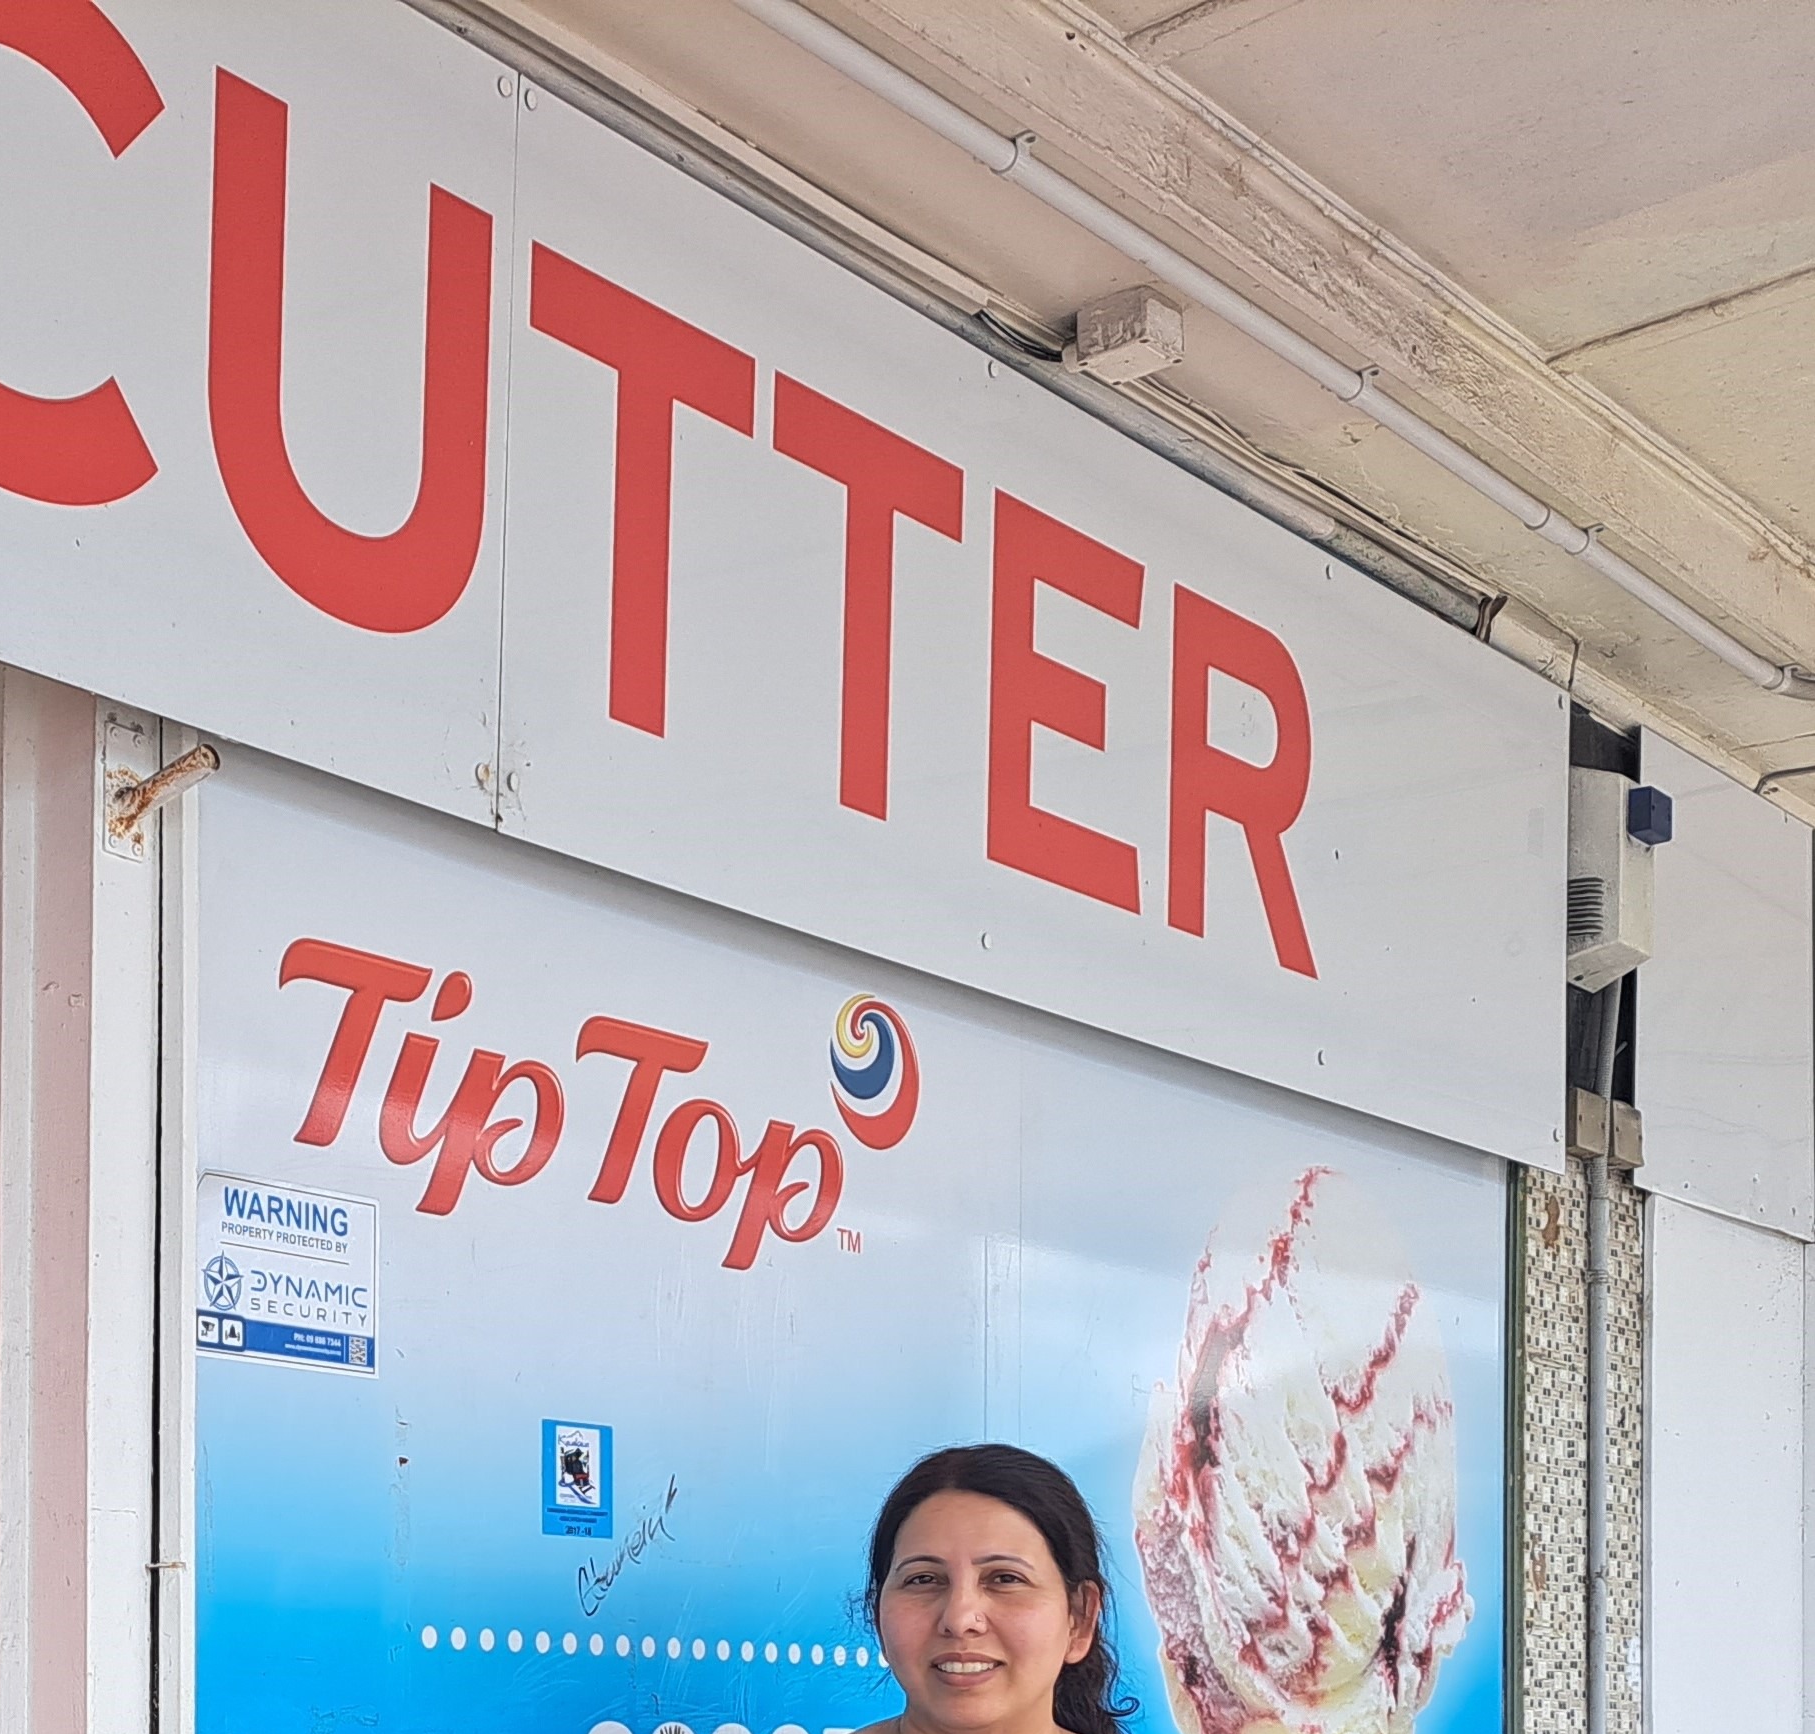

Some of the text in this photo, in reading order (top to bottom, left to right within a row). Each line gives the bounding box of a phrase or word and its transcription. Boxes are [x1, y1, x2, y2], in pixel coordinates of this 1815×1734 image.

[279, 938, 844, 1271] Tip Top
[223, 1186, 348, 1237] WARNING
[221, 1221, 348, 1254] PROPERTY PROTECTED BY
[836, 1227, 861, 1254] TM
[250, 1270, 368, 1309] DYNAMIC
[250, 1298, 368, 1327] SECURITY
